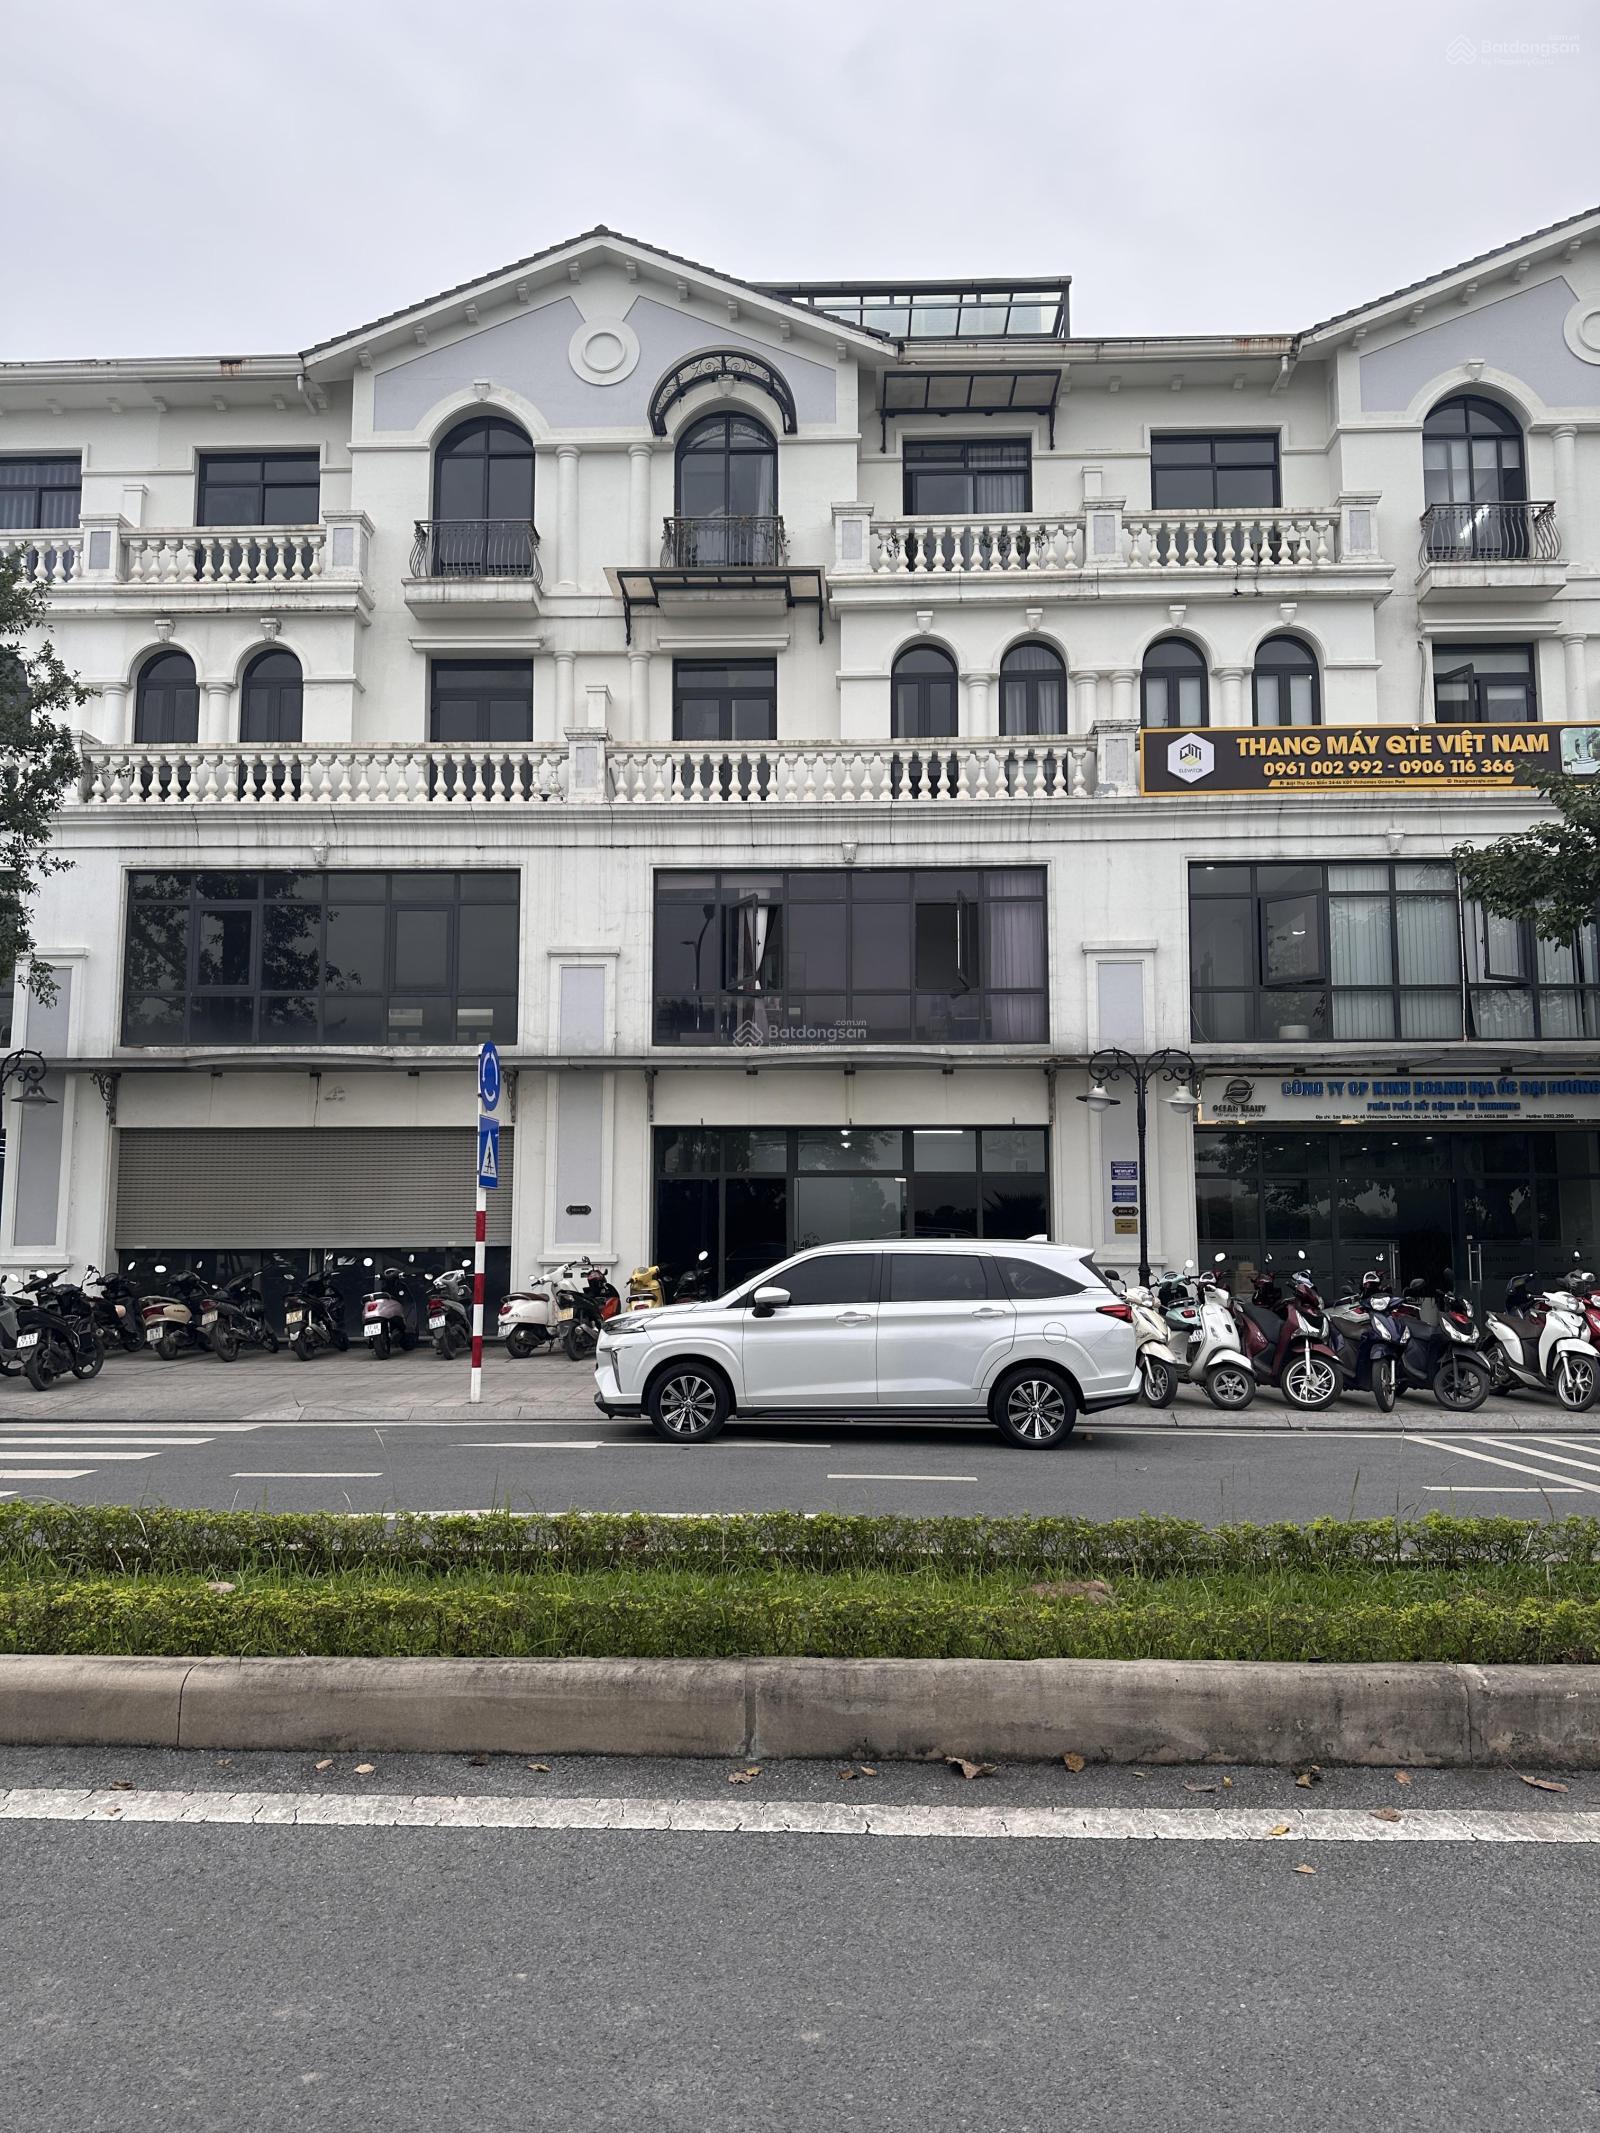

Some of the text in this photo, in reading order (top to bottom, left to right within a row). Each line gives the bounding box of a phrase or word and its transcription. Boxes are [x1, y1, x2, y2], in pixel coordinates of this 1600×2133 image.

[1236, 729, 1550, 758] THANG MÁY QTE VIỆT NAM
[1263, 761, 1306, 776] 0961
[1310, 761, 1344, 775] 002
[1348, 760, 1383, 774] 992
[1399, 759, 1445, 774] 0906
[1449, 759, 1477, 773] 116
[1480, 759, 1515, 773] 366
[1326, 1081, 1346, 1096] TY
[1348, 1081, 1369, 1096] CP
